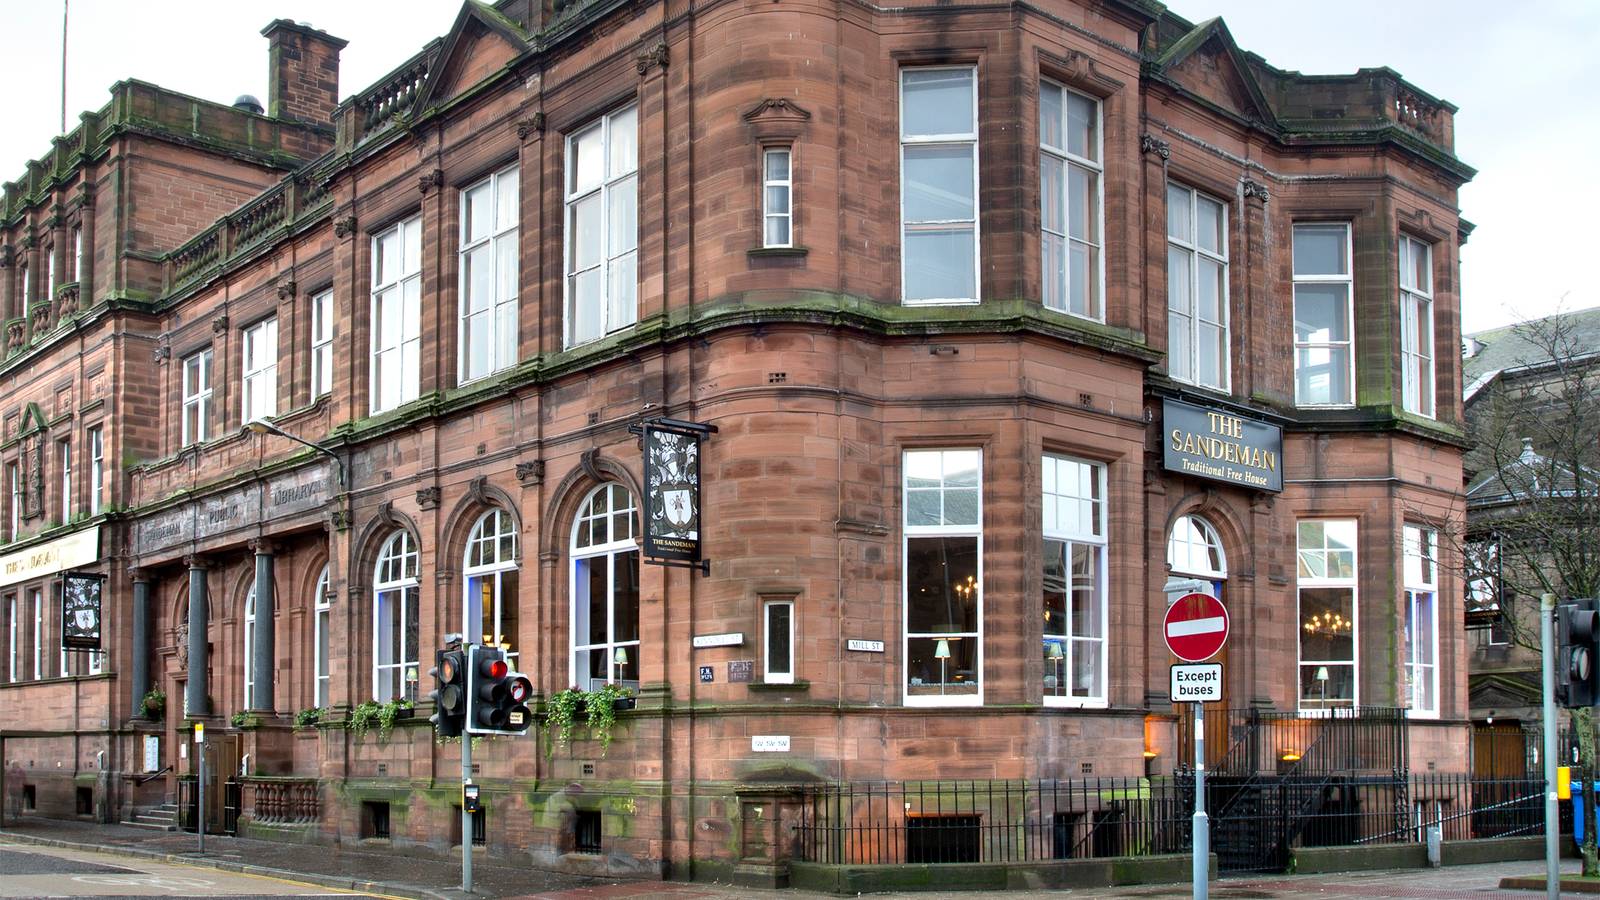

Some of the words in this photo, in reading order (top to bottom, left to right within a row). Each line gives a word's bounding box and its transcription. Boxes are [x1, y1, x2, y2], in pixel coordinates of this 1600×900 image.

[1207, 412, 1242, 439] THE
[1171, 429, 1275, 472] SANDEMAN
[1182, 458, 1225, 477] Traditional
[1227, 468, 1243, 481] Free
[1245, 471, 1267, 486] House
[209, 506, 239, 525] PUBLIC
[652, 538, 664, 546] THE
[664, 540, 696, 549] SANDEMAN
[852, 641, 869, 650] MILL
[871, 642, 880, 650] ST
[1176, 670, 1217, 683] Except
[1179, 685, 1213, 695] buses
